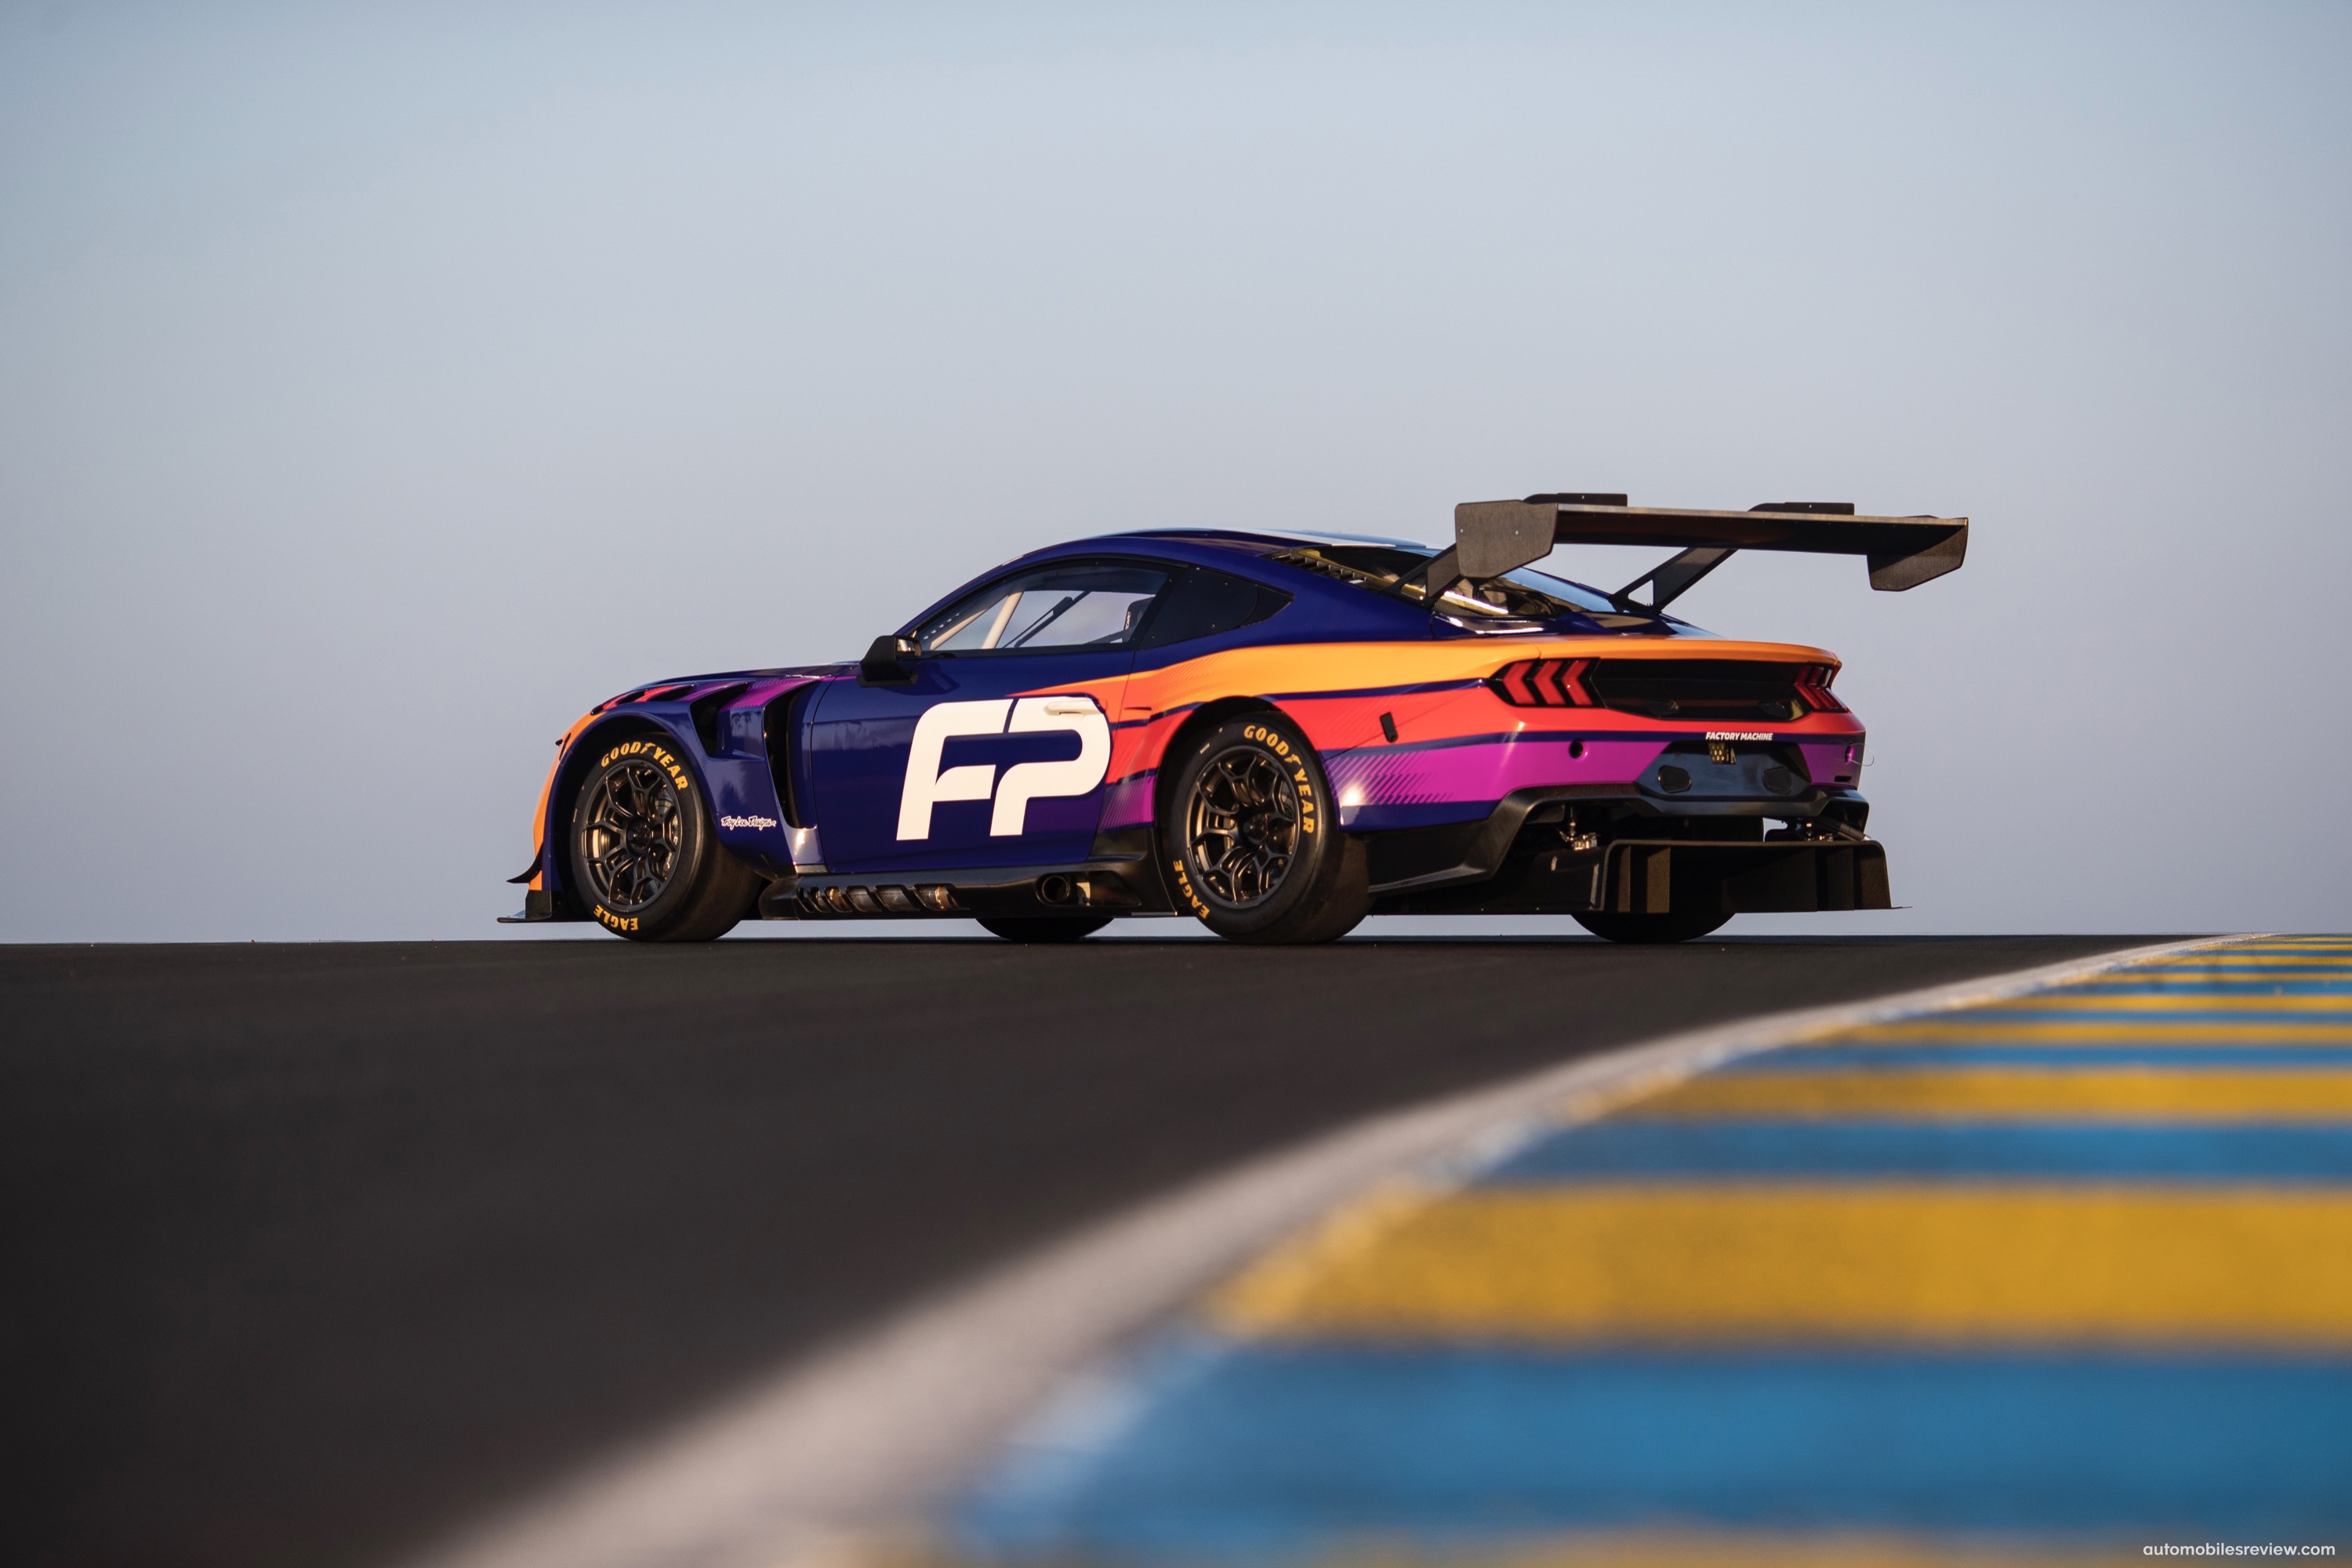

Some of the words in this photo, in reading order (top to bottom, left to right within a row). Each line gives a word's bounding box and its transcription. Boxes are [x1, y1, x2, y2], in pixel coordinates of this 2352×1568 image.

[1705, 731, 1740, 740] FACTORY
[1740, 732, 1773, 741] MACHINE
[601, 741, 688, 790] GOODYEAR
[896, 695, 1111, 840] FP
[1243, 724, 1315, 834] GOODYEAR
[721, 815, 736, 830] Troy
[1173, 859, 1210, 920] EAGLE
[593, 904, 639, 931] EAGLE
